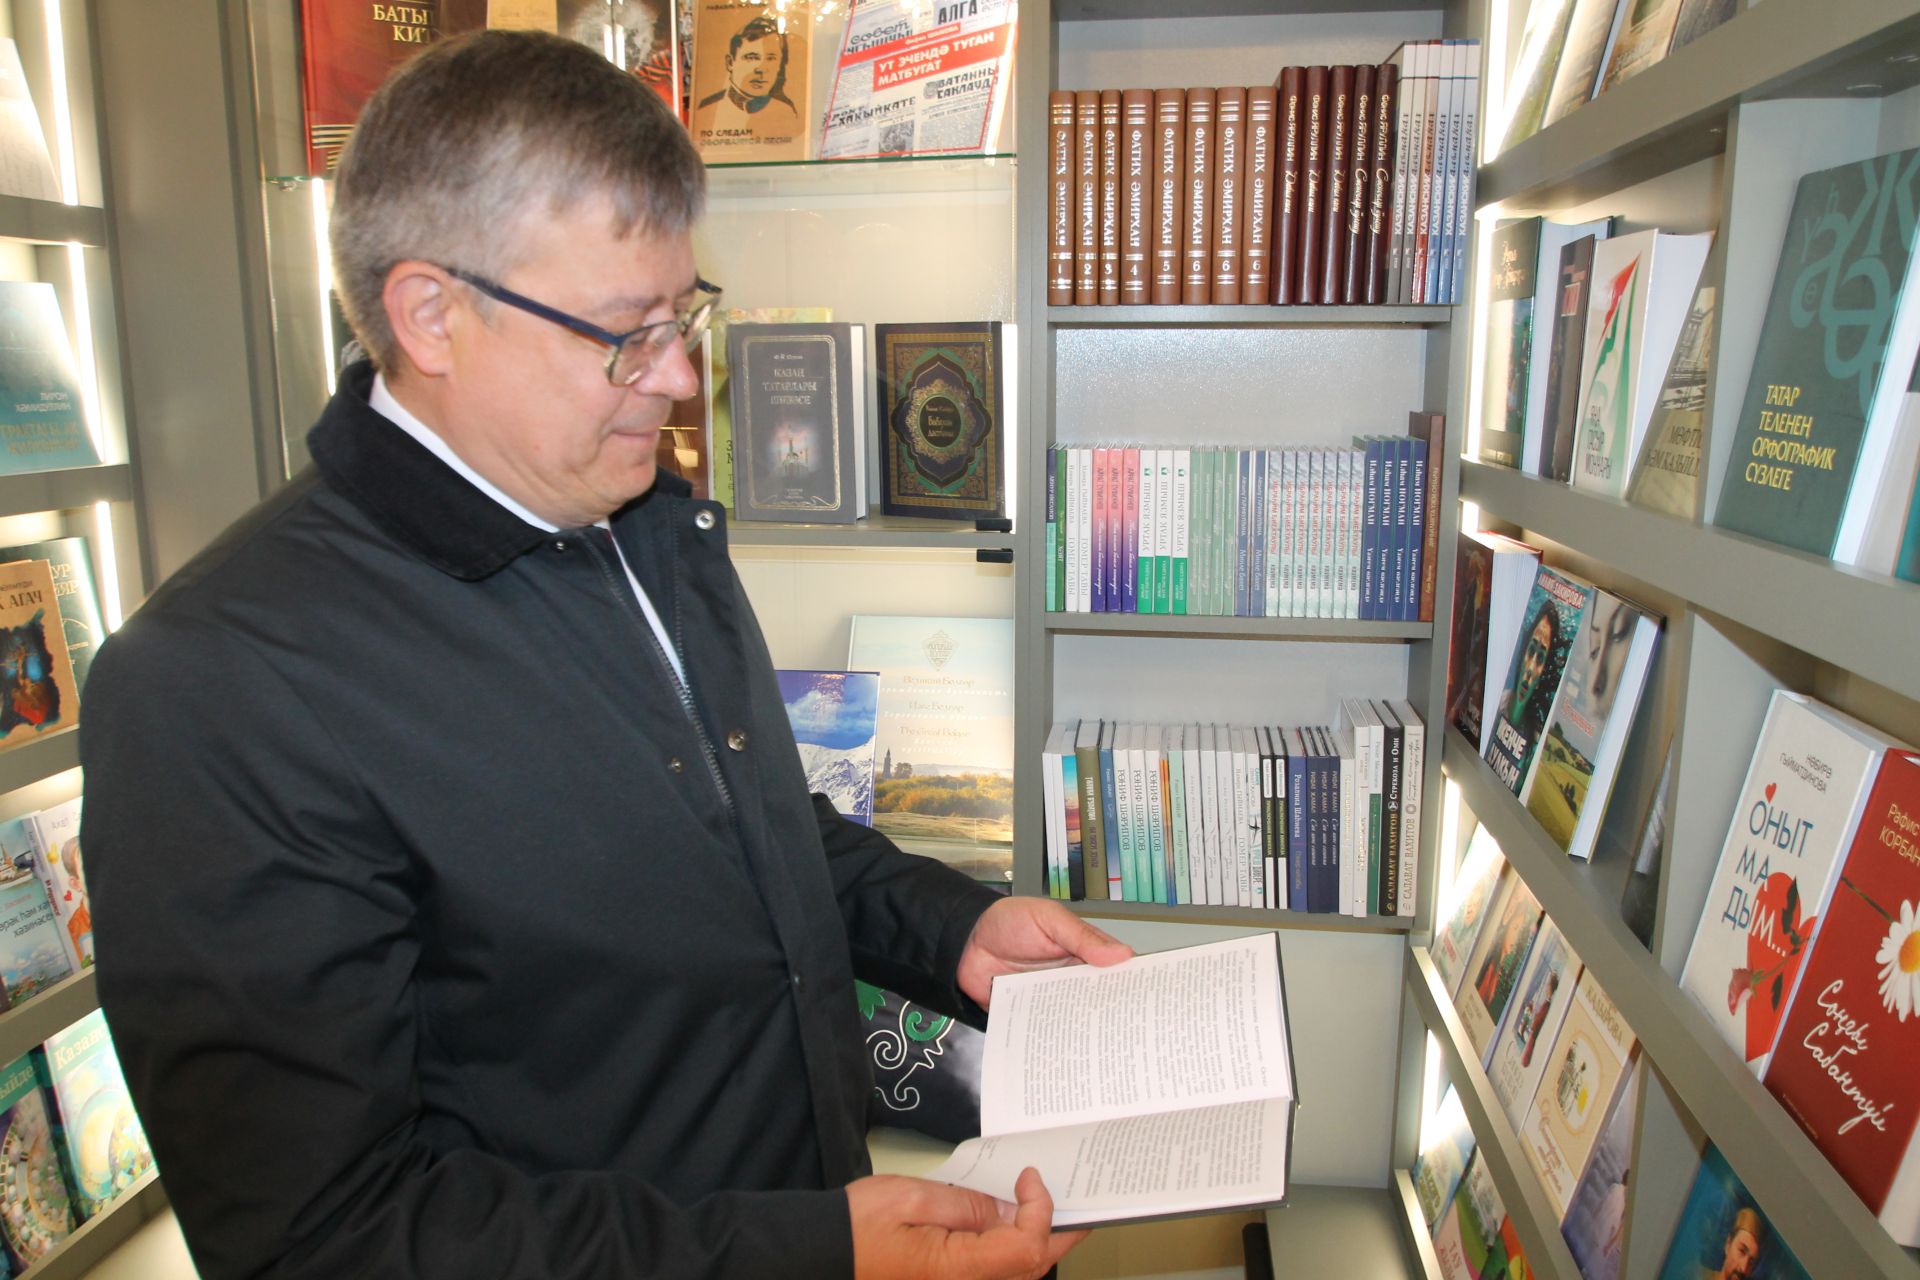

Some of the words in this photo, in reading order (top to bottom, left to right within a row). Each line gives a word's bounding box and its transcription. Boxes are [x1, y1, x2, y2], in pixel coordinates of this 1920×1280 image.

[938, 0, 978, 25] АЛГА
[878, 60, 895, 72] УТ
[898, 45, 949, 68] ЭЧЕНДӘ
[952, 32, 994, 52] ТУГАН
[878, 60, 942, 86] МАТБУГАТ
[716, 128, 753, 137] СЛЕДАМ
[1163, 128, 1175, 174] ФАТИХ
[1194, 128, 1205, 174] ФАТИХ
[1223, 127, 1235, 174] ФАТИХ
[1255, 126, 1266, 173] ФАТИХ
[1083, 130, 1094, 176] ФАТИХ
[1104, 130, 1115, 175] ФАТИХ
[1131, 130, 1142, 177] ФАТИХ
[1104, 181, 1115, 246] ӘМИРХАН
[1130, 181, 1141, 247] ӘМИРХАН
[1161, 179, 1173, 245] ӘМИРХАН
[1192, 179, 1203, 245] ӘМИРХАН
[1221, 179, 1234, 245] ӘМИРХАН
[1253, 178, 1264, 244] ӘМИРХАН
[1131, 266, 1137, 275] 4
[1163, 261, 1170, 272] 5
[1193, 261, 1200, 272] 6
[1223, 260, 1230, 271] 6
[1253, 260, 1261, 271] 6
[1765, 384, 1801, 406] ТАТАР
[1758, 411, 1814, 440] ТЕЛЕНЕҢ
[1752, 436, 1836, 471] ОРФОГРАФИК
[1143, 482, 1151, 520] ЯЗМЫШ
[1159, 481, 1168, 518] ЯЗМЫШ
[1176, 483, 1185, 521] ЯЗМЫШ
[1142, 522, 1151, 551] УРТАК
[1159, 522, 1168, 550] УРТАК
[1176, 523, 1185, 552] УРТАК
[10, 590, 43, 608] АГАЧ
[1118, 769, 1128, 801] РӘНИФ
[1133, 770, 1144, 802] РӘНИФ
[1149, 770, 1159, 802] РӘНИФ
[1120, 803, 1130, 850] ШӘРИПОВ
[1135, 804, 1145, 851] ШӘРИПОВ
[1151, 805, 1161, 852] ШӘРИПОВ
[1389, 813, 1398, 856] ВАХИТОВ
[1404, 818, 1415, 858] ВАХИТОВ
[1750, 800, 1814, 858] ОНЫТ
[1886, 802, 1920, 838] Рафис
[1388, 858, 1397, 900] САЛАВАТ
[1402, 861, 1414, 899] САЛАВАТ
[1736, 844, 1769, 892] МА
[1803, 1022, 1895, 1135] Сабантуй
